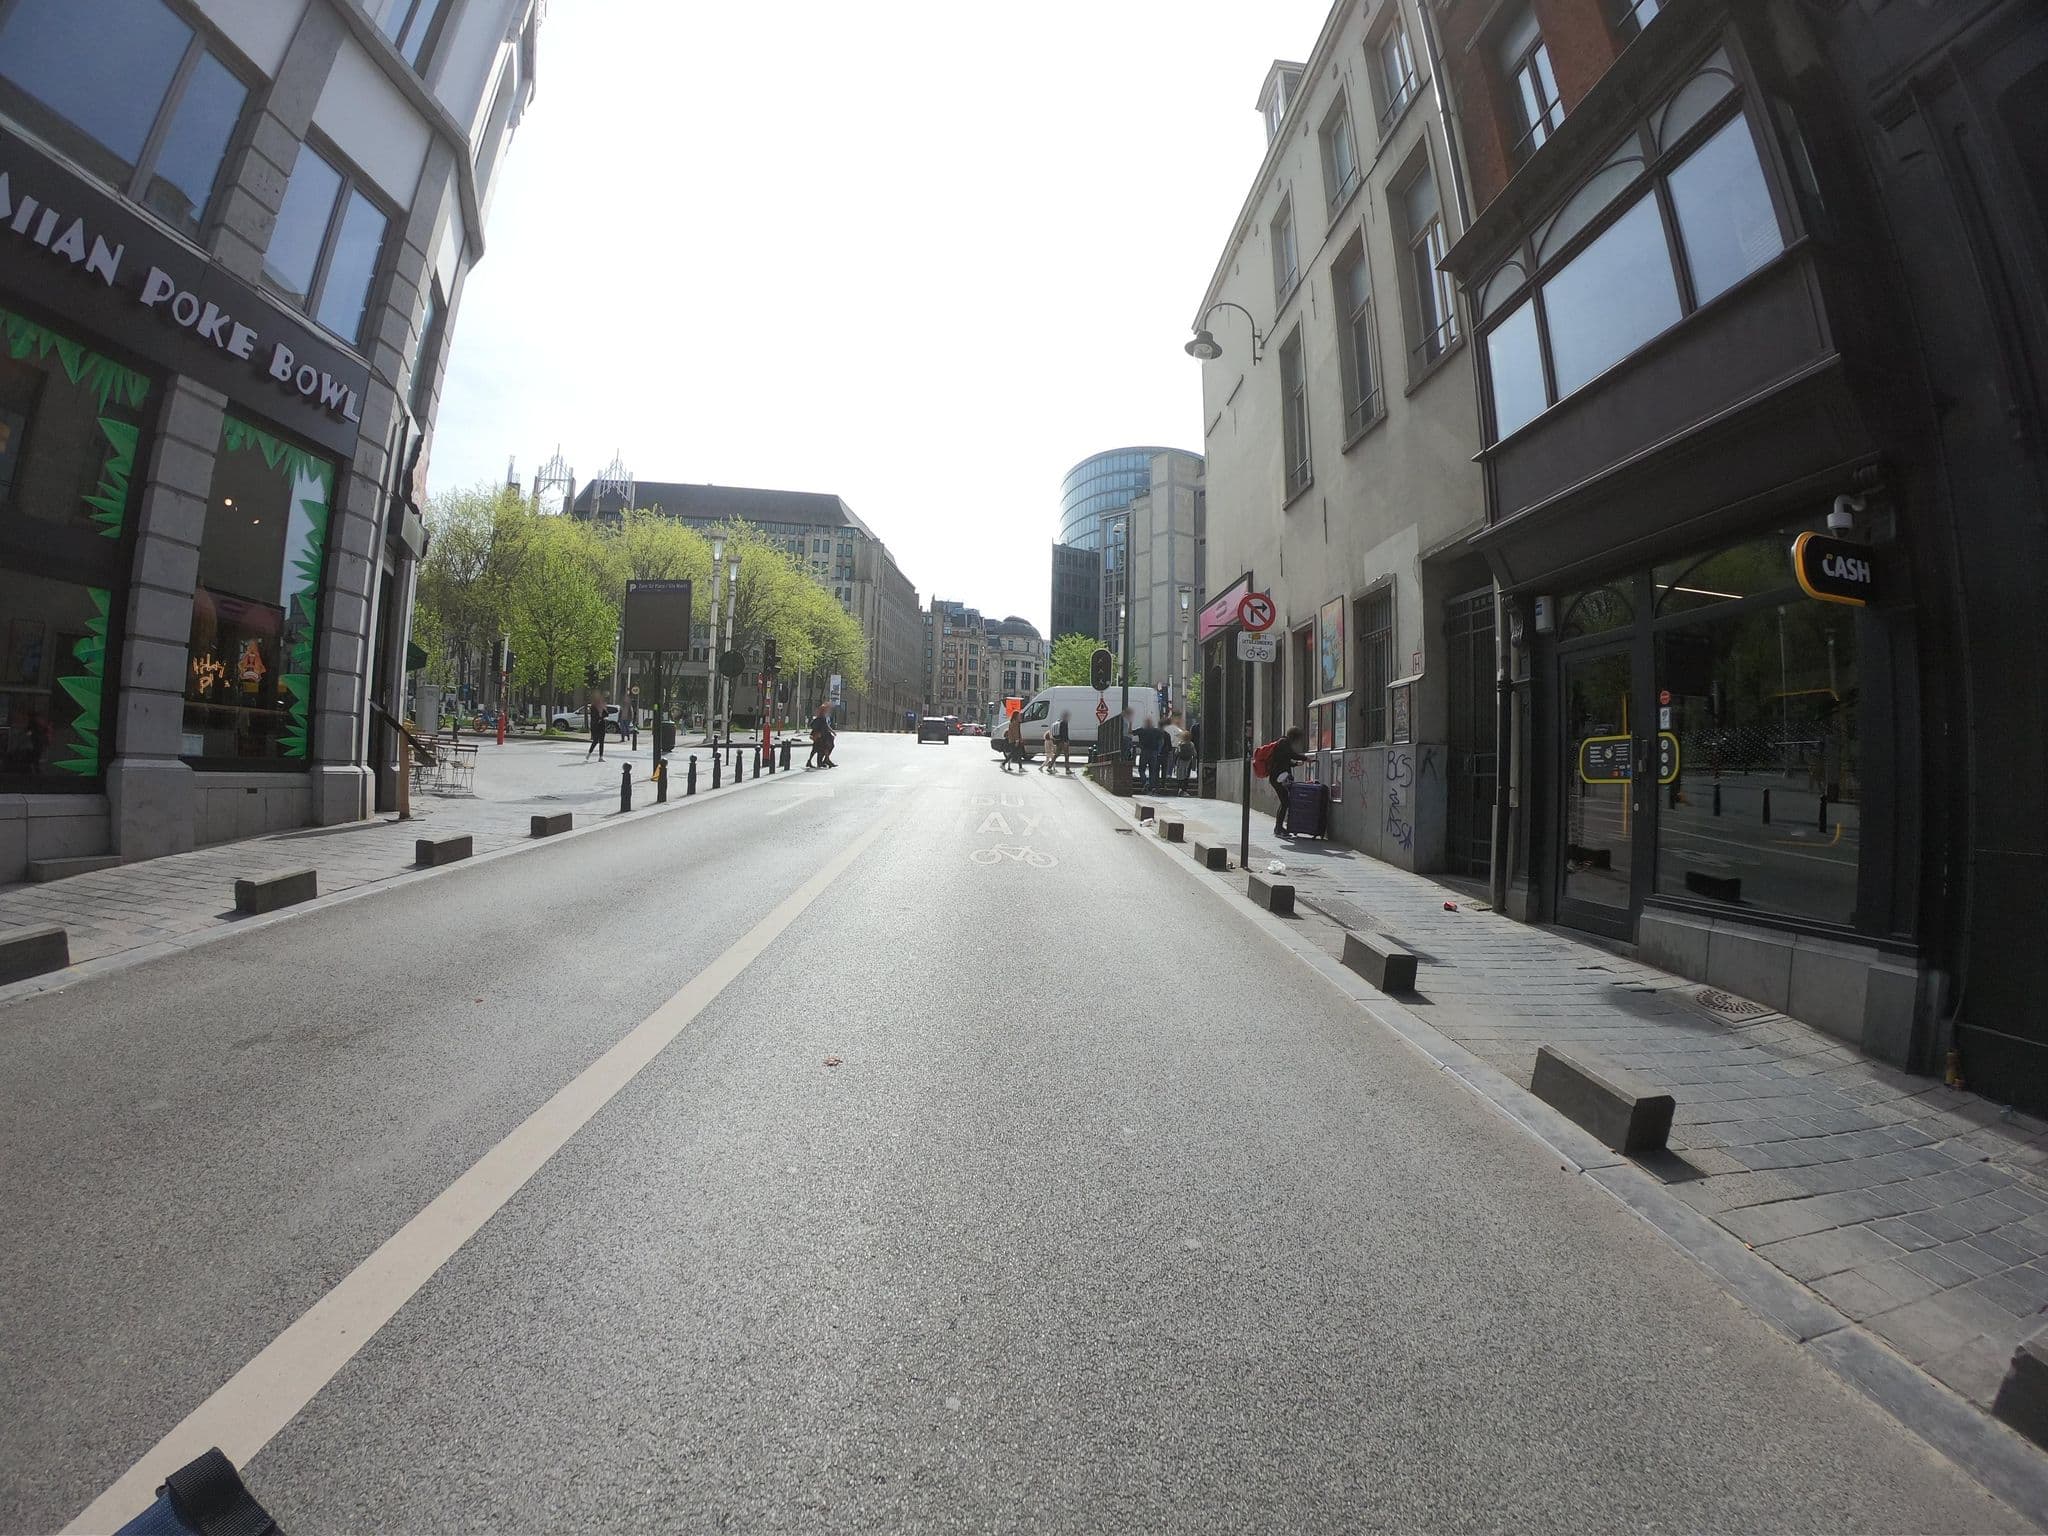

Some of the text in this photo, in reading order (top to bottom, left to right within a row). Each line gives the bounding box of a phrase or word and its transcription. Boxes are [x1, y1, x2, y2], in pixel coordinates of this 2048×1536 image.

[139, 266, 258, 360] POKE
[269, 342, 360, 423] BOWL
[1822, 554, 1871, 583] CASH
